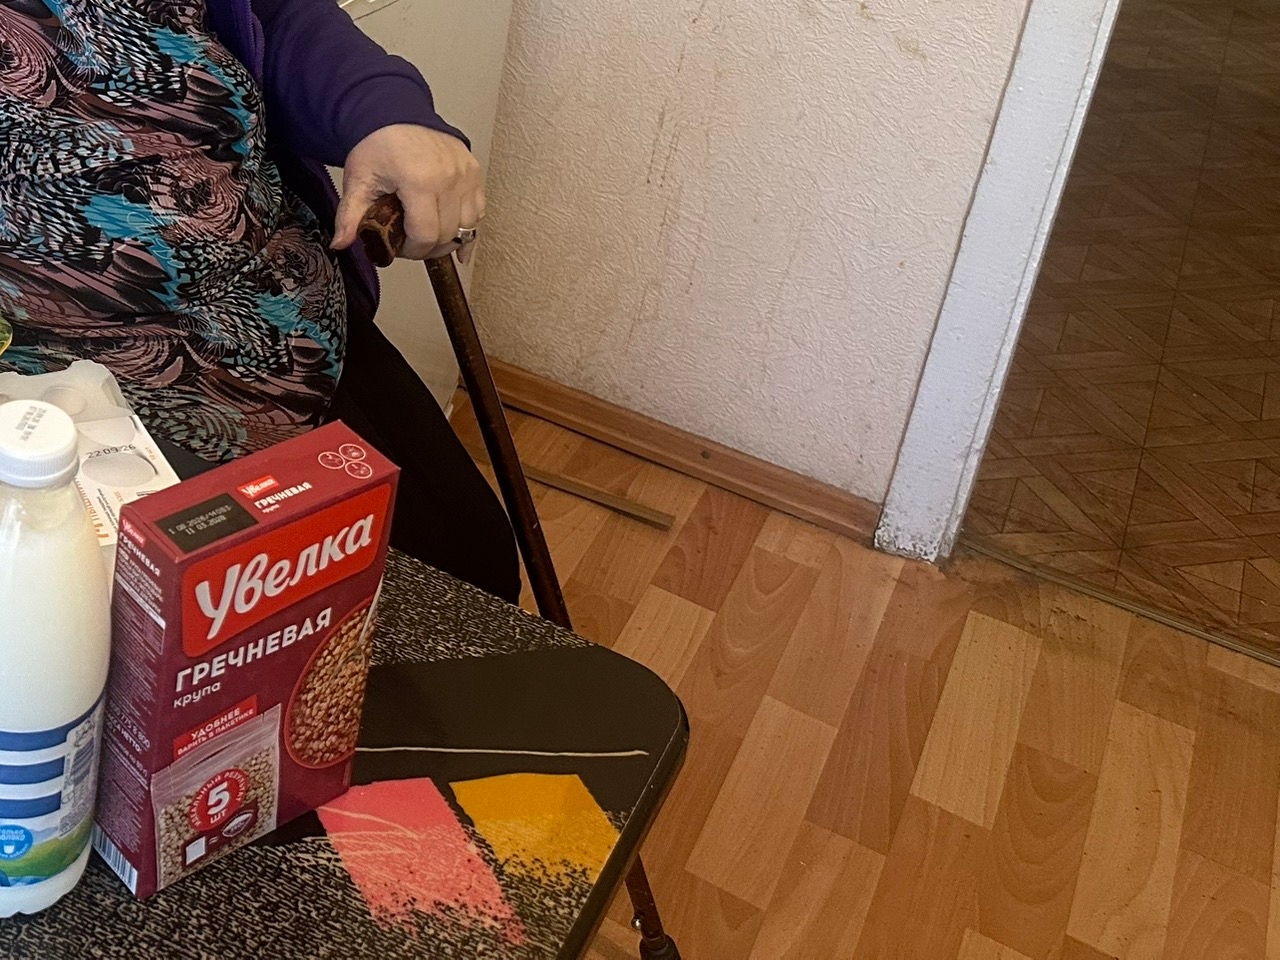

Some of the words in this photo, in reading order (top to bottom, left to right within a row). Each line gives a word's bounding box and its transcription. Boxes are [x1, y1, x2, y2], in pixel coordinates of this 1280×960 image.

[254, 481, 313, 510] ГРЕЧНЕВАЯ
[194, 514, 376, 640] Увелка
[175, 607, 332, 692] ГРЕЧНЕВАЯ
[173, 681, 221, 708] крупа
[191, 707, 240, 740] УДОБНЕЕ
[207, 781, 230, 815] 5
